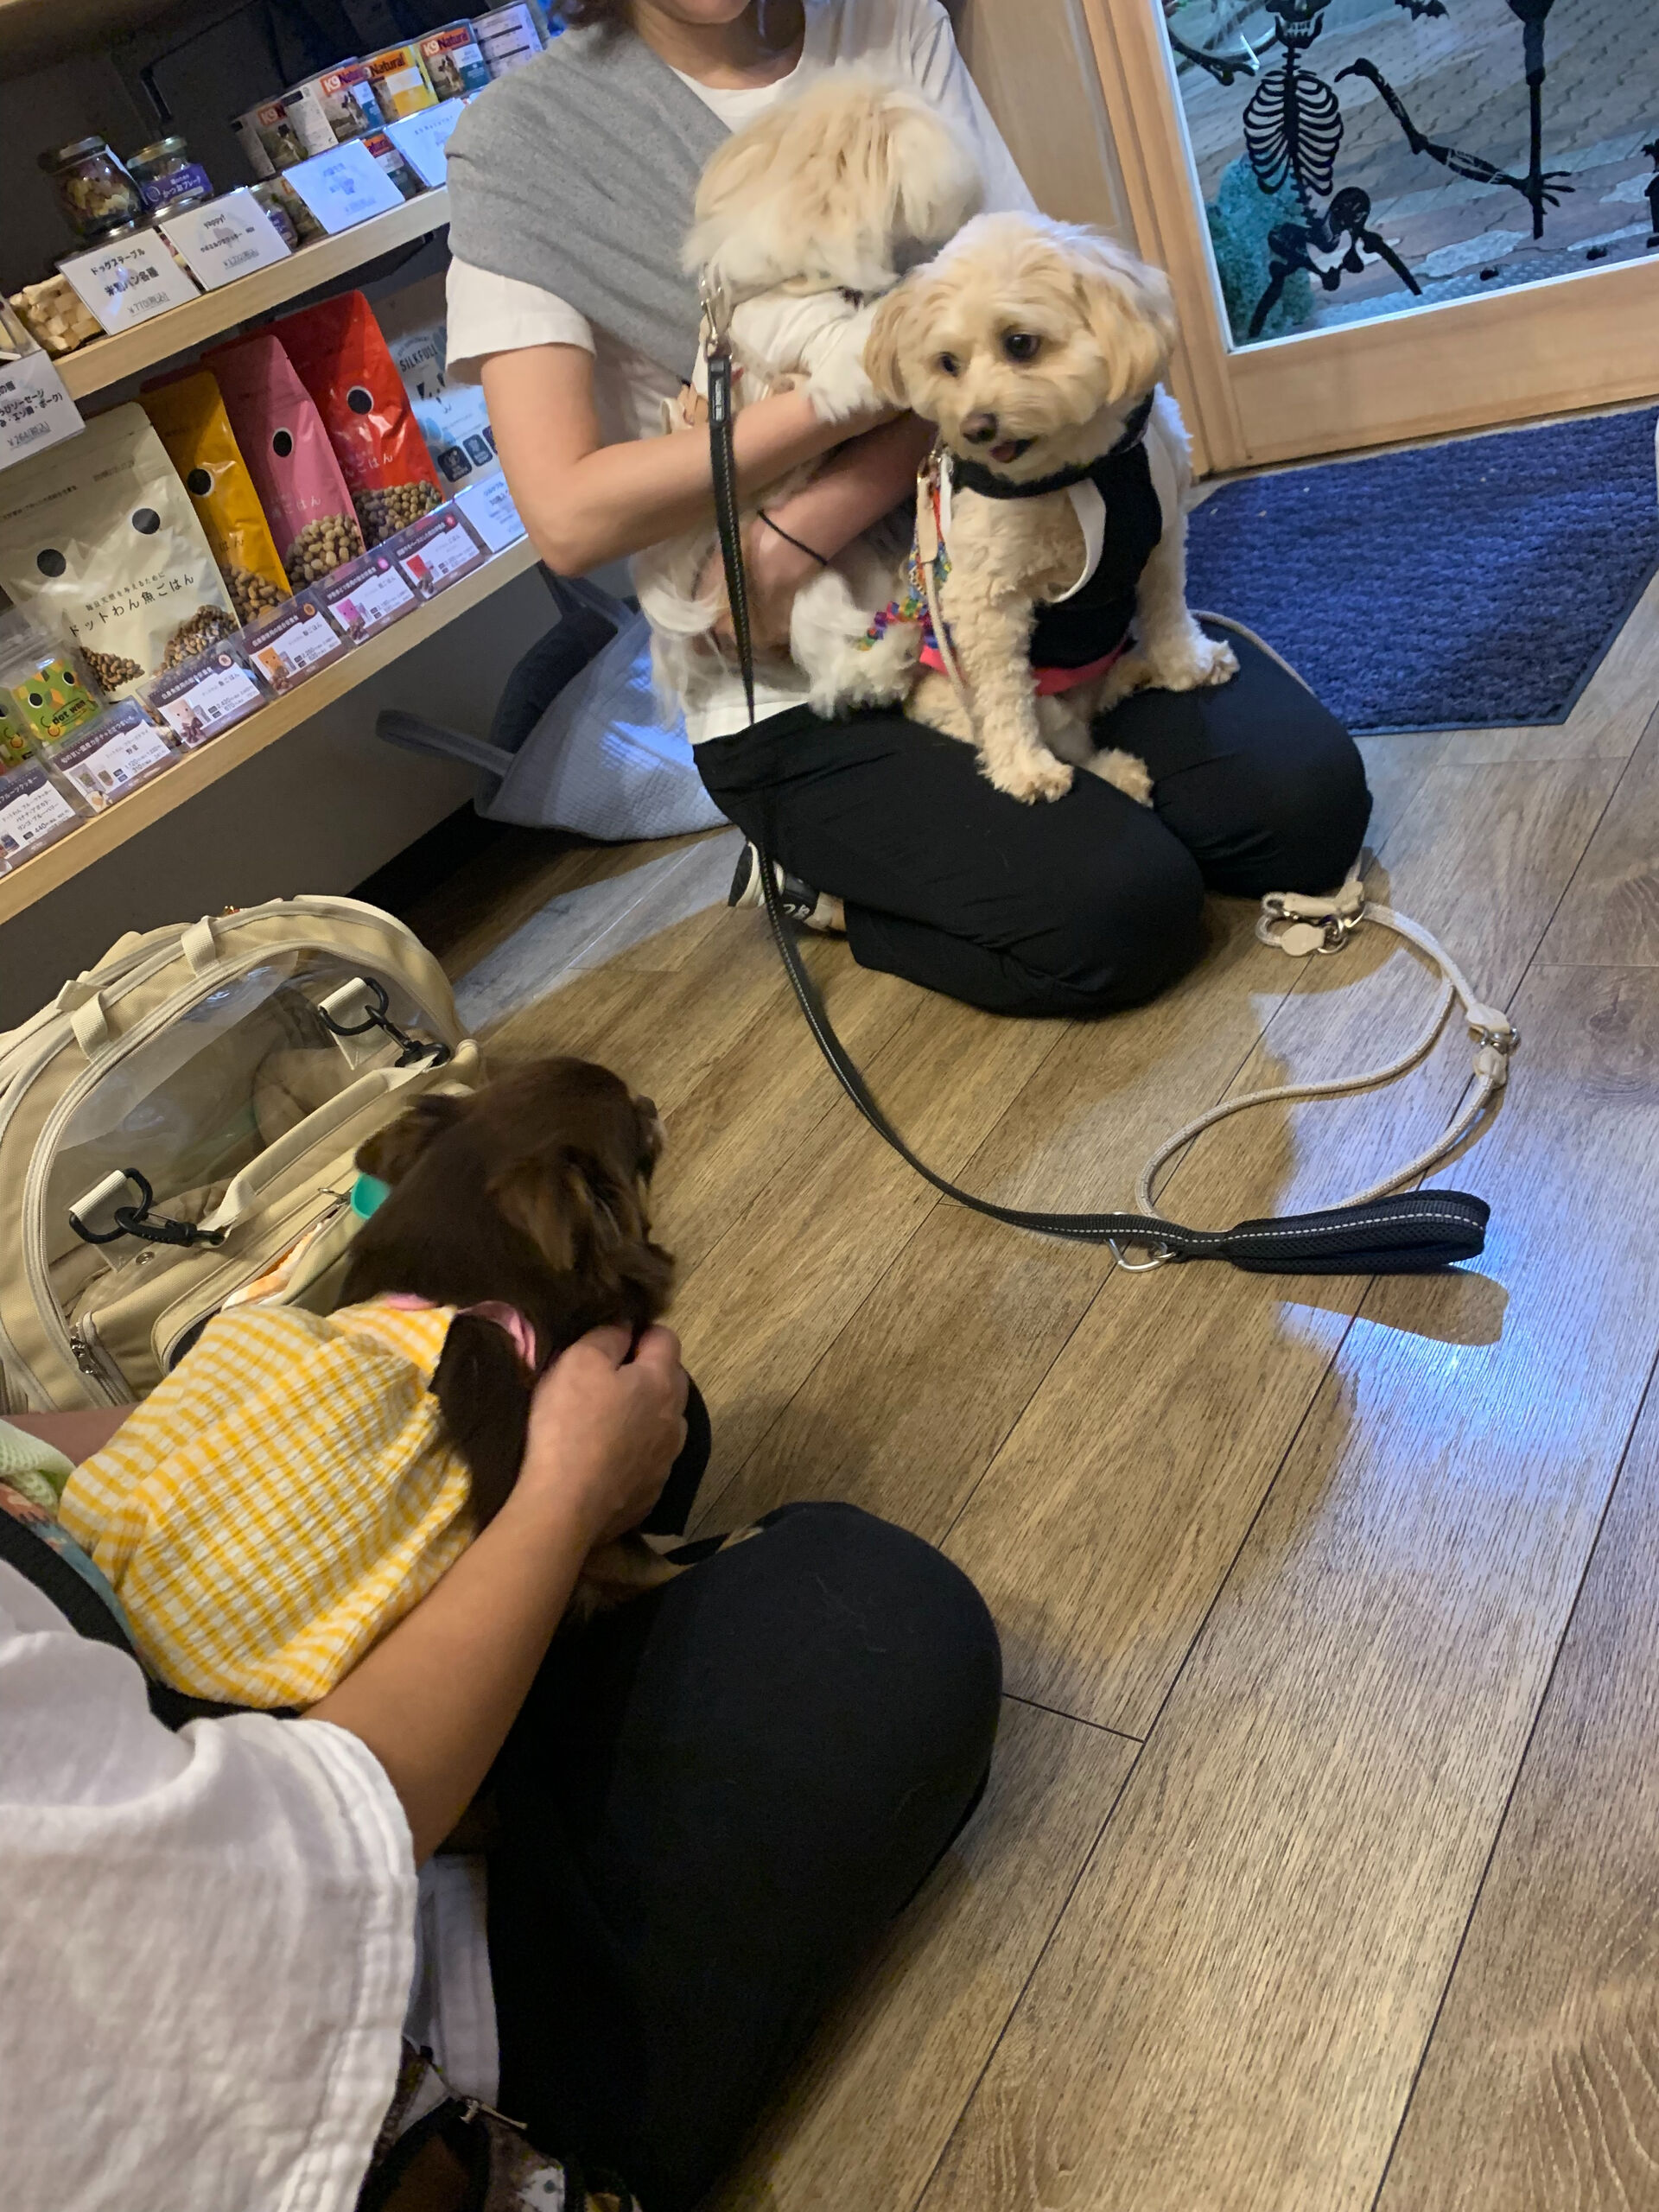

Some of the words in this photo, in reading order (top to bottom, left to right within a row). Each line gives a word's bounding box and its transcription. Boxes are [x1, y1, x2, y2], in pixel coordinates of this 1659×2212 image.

[437, 30, 468, 48] Natural
[369, 53, 406, 77] Natural
[323, 75, 340, 92] K9
[69, 574, 194, 638] ドットわん魚ごはん
[52, 710, 69, 725] dot
[0, 776, 38, 804] フルーツクッキー
